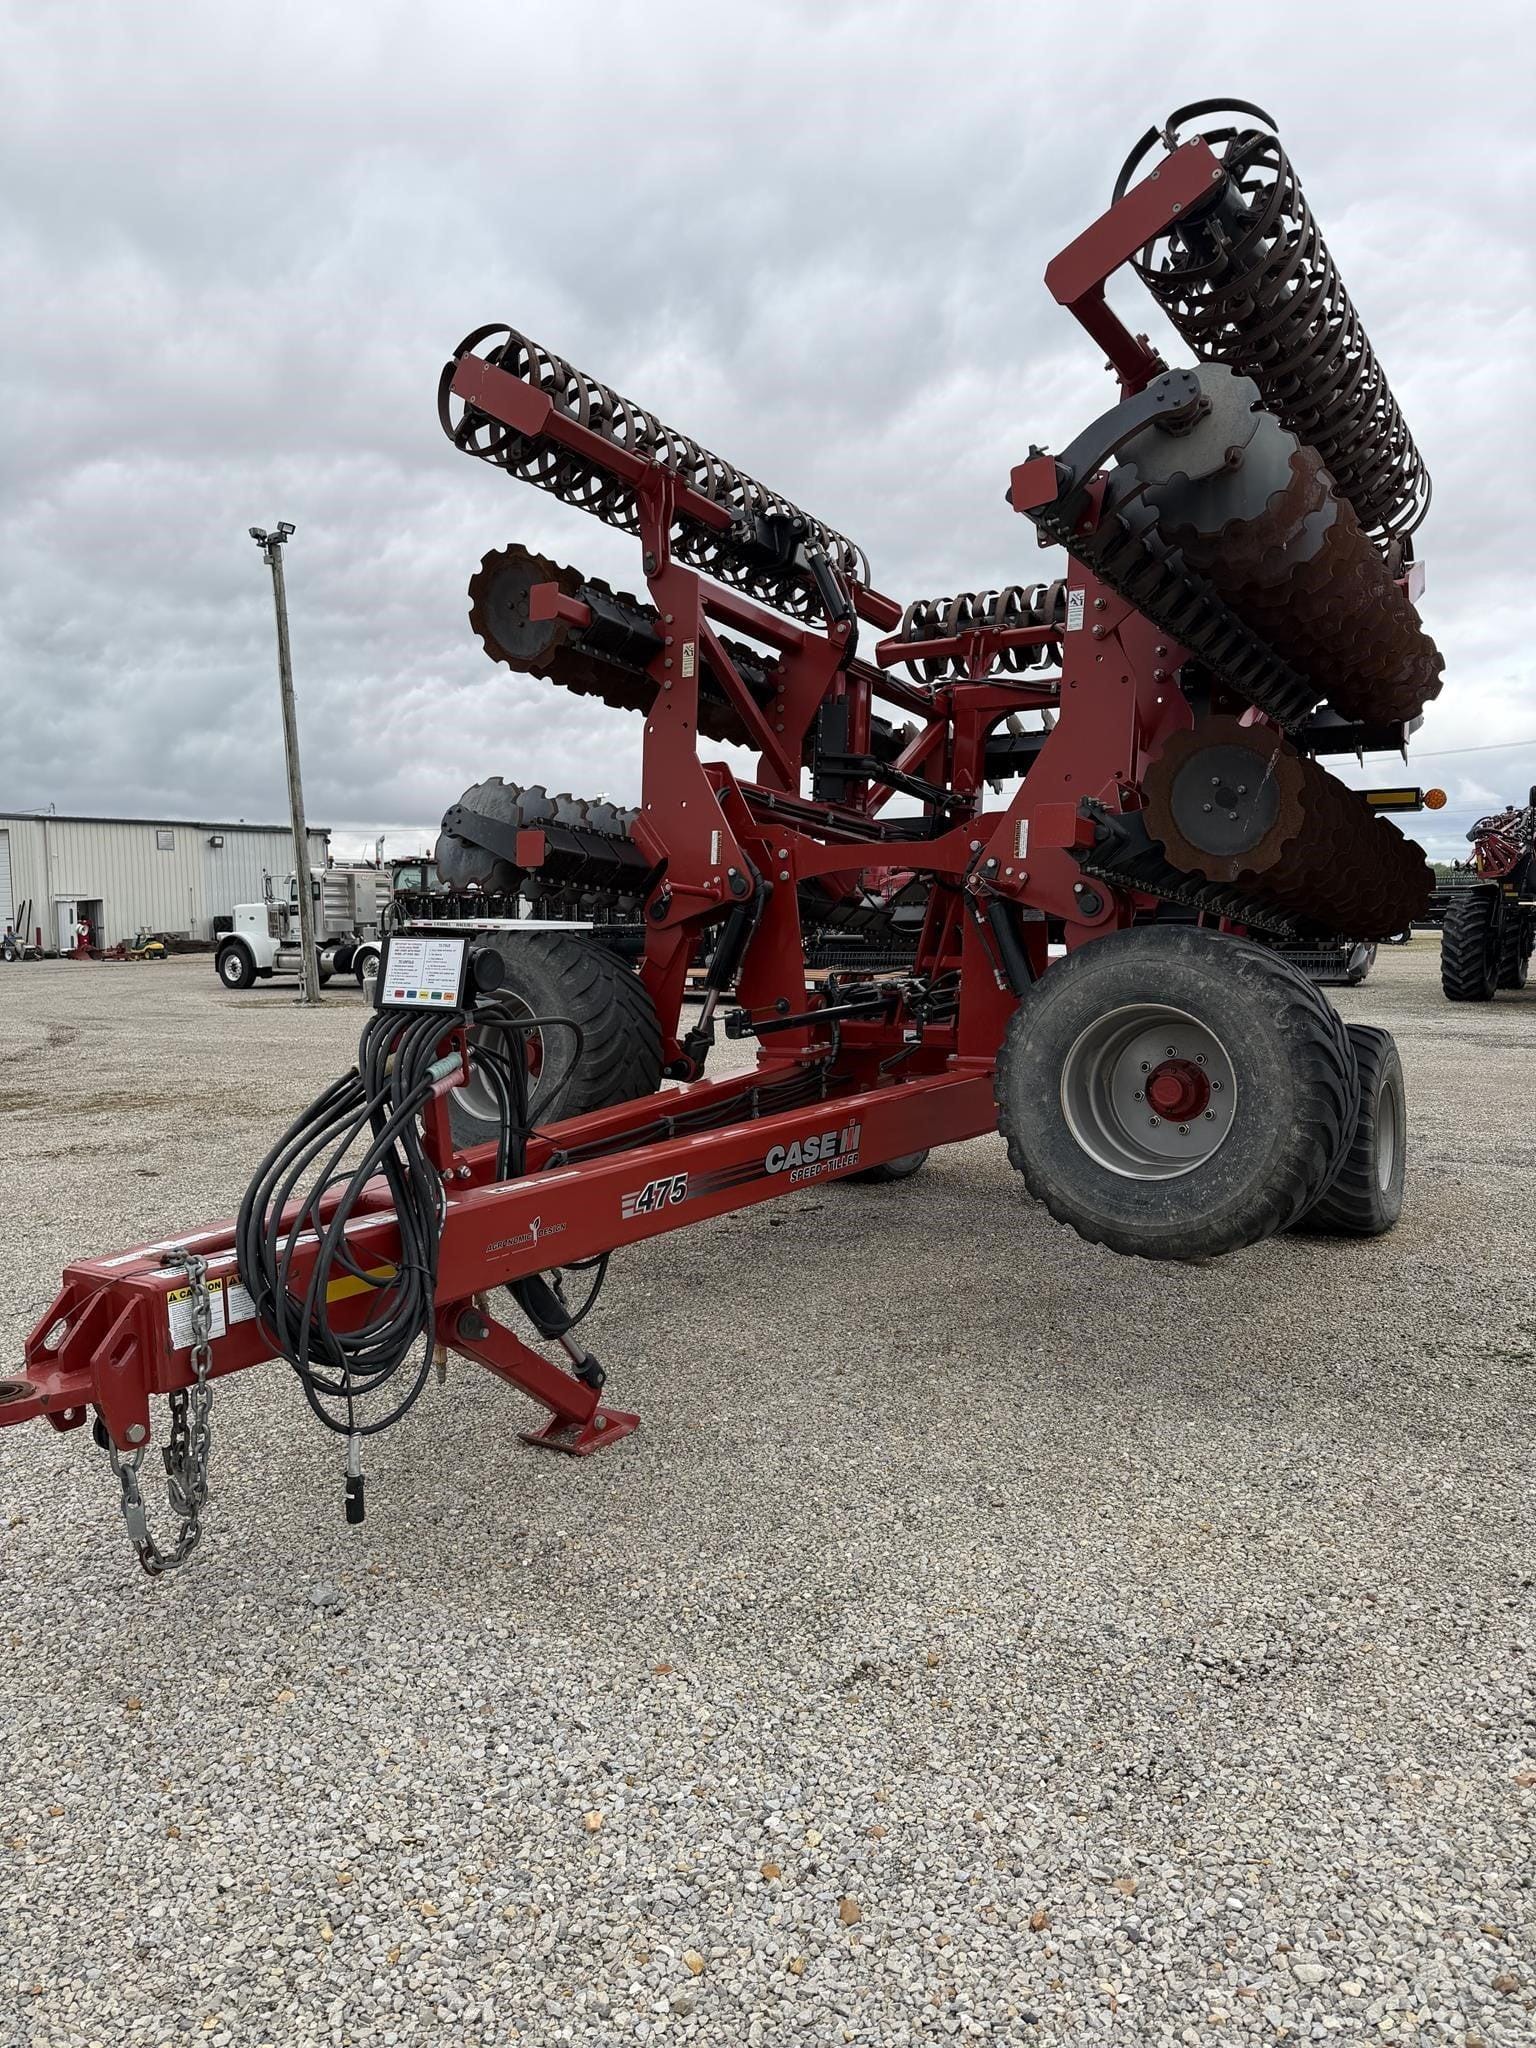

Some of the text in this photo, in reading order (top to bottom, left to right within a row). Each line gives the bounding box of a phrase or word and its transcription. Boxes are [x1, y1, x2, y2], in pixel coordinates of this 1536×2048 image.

[765, 1130, 838, 1175] CASE
[790, 1152, 859, 1184] SPEED-TILLER
[635, 1172, 689, 1214] 475
[485, 1223, 567, 1254] AGRONOMIC DESIGN
[179, 1280, 221, 1299] CAON
